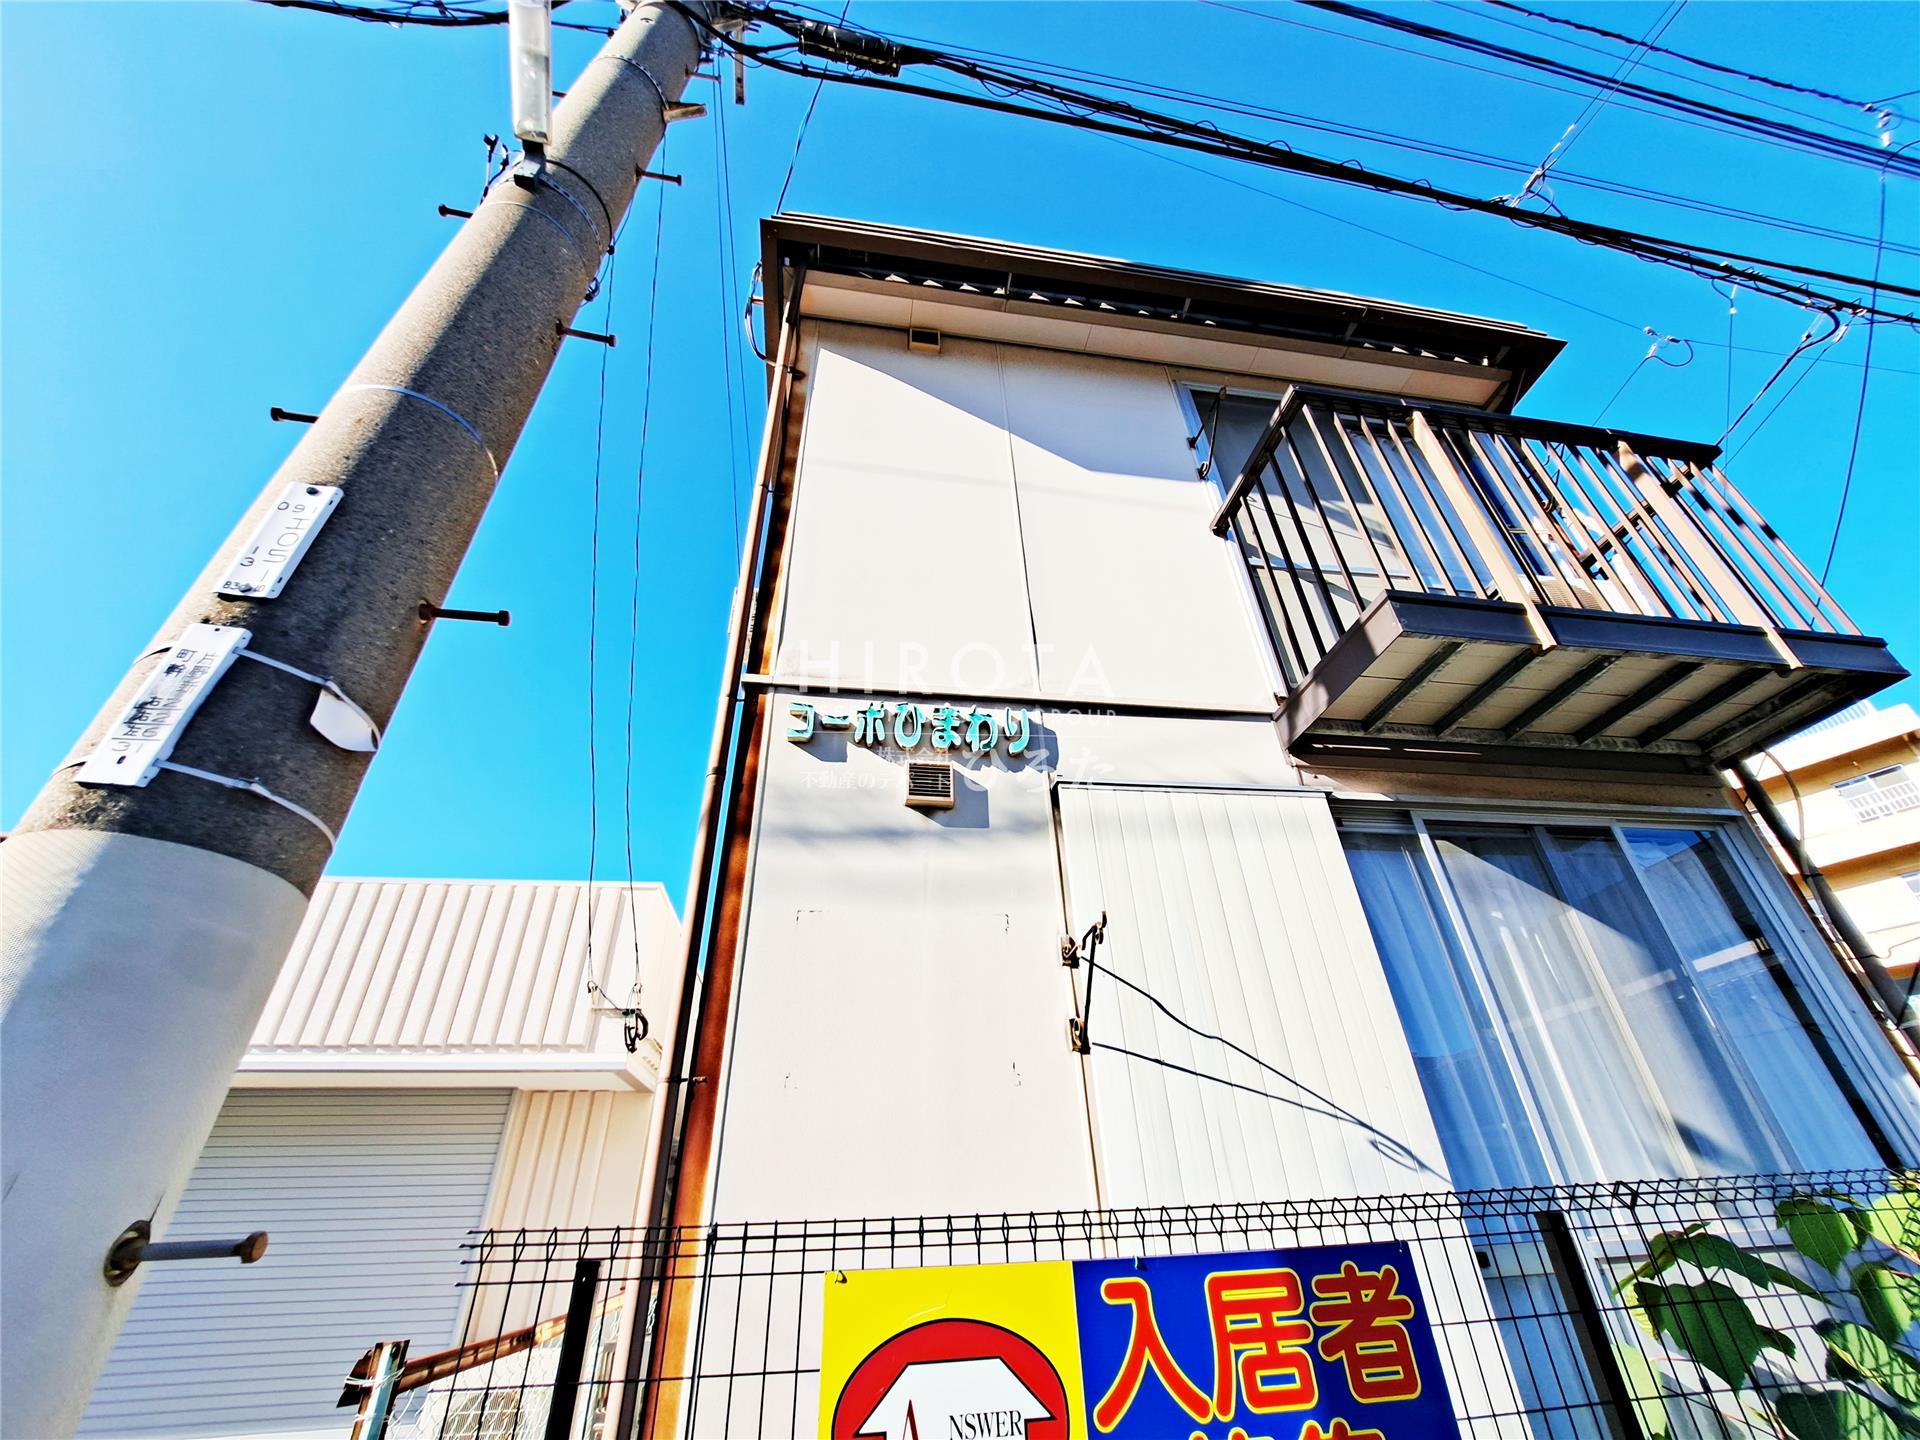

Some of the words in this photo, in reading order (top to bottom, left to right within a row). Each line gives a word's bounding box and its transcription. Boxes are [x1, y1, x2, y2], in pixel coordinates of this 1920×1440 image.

[786, 701, 1031, 758] コーポひまわり
[1093, 1261, 1422, 1431] 入居者
